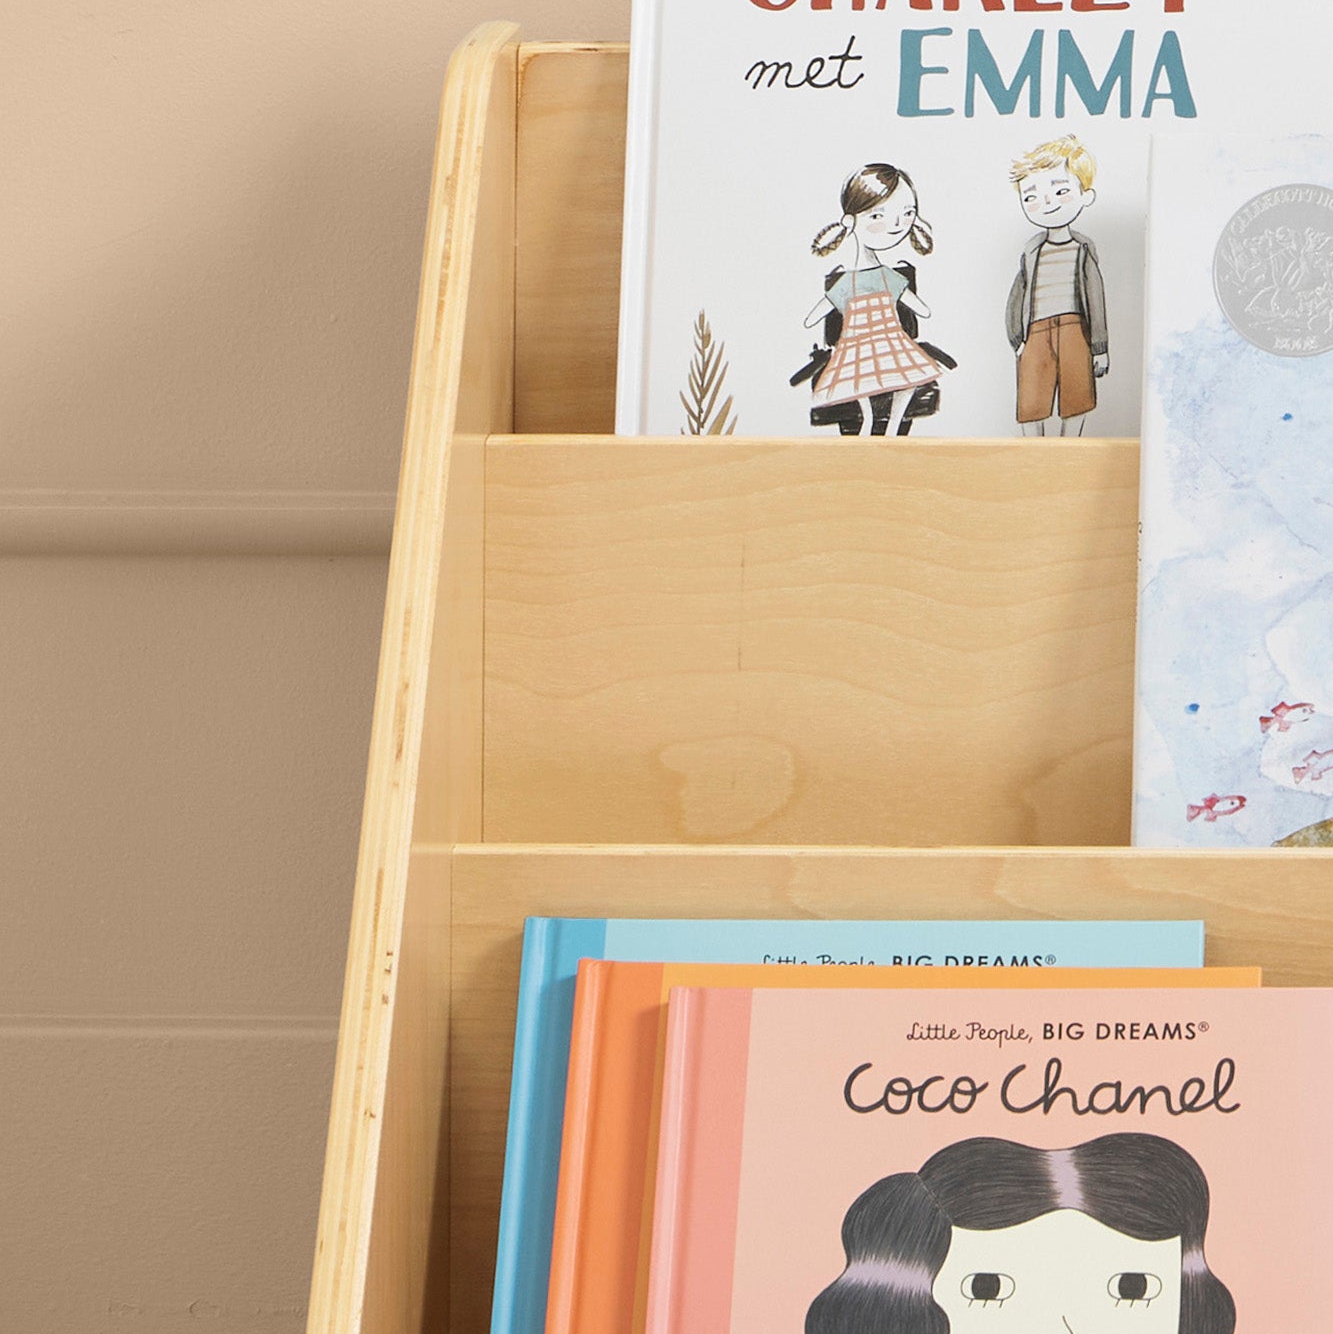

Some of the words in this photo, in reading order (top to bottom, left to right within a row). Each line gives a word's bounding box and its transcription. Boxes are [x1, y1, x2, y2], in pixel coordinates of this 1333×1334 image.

[745, 35, 866, 91] met
[897, 27, 1199, 120] EMMA
[906, 1021, 962, 1041] Little
[965, 1021, 1034, 1049] People,
[1042, 1022, 1086, 1041] BIG
[843, 1061, 990, 1115] Coco
[1000, 1057, 1242, 1116] Chanel
